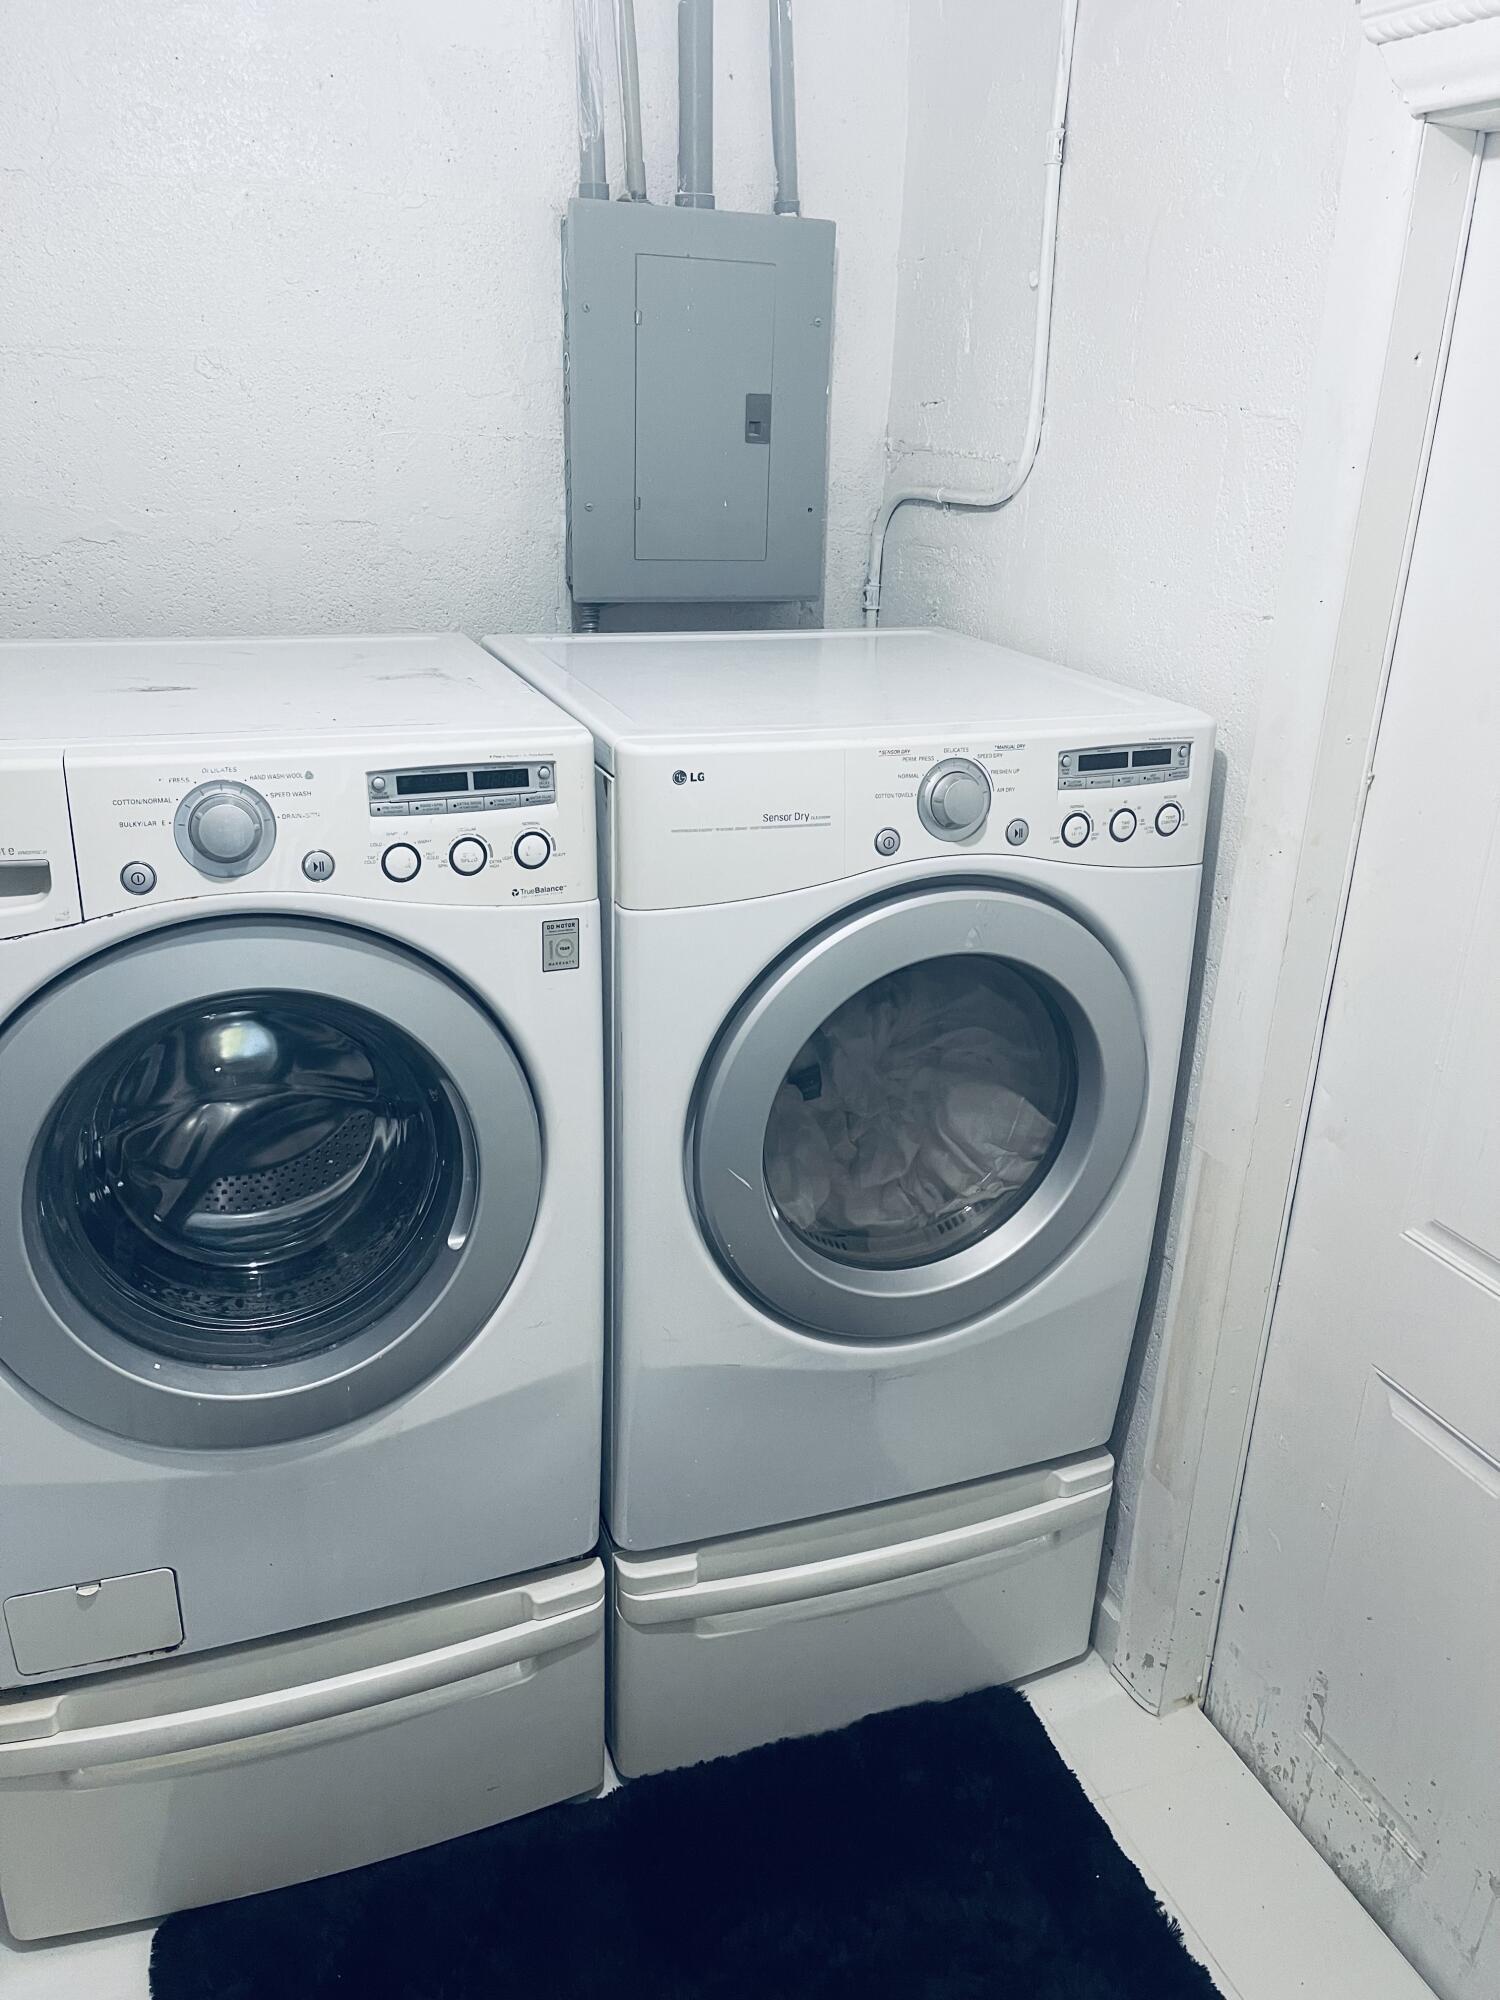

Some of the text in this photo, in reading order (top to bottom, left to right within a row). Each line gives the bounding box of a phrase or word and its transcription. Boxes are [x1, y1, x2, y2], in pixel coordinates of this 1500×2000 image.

[690, 772, 705, 782] LG
[292, 790, 312, 798] WASH
[762, 812, 792, 823] Sensor
[794, 812, 810, 823] Dry
[119, 820, 165, 828] BULKY/LARE
